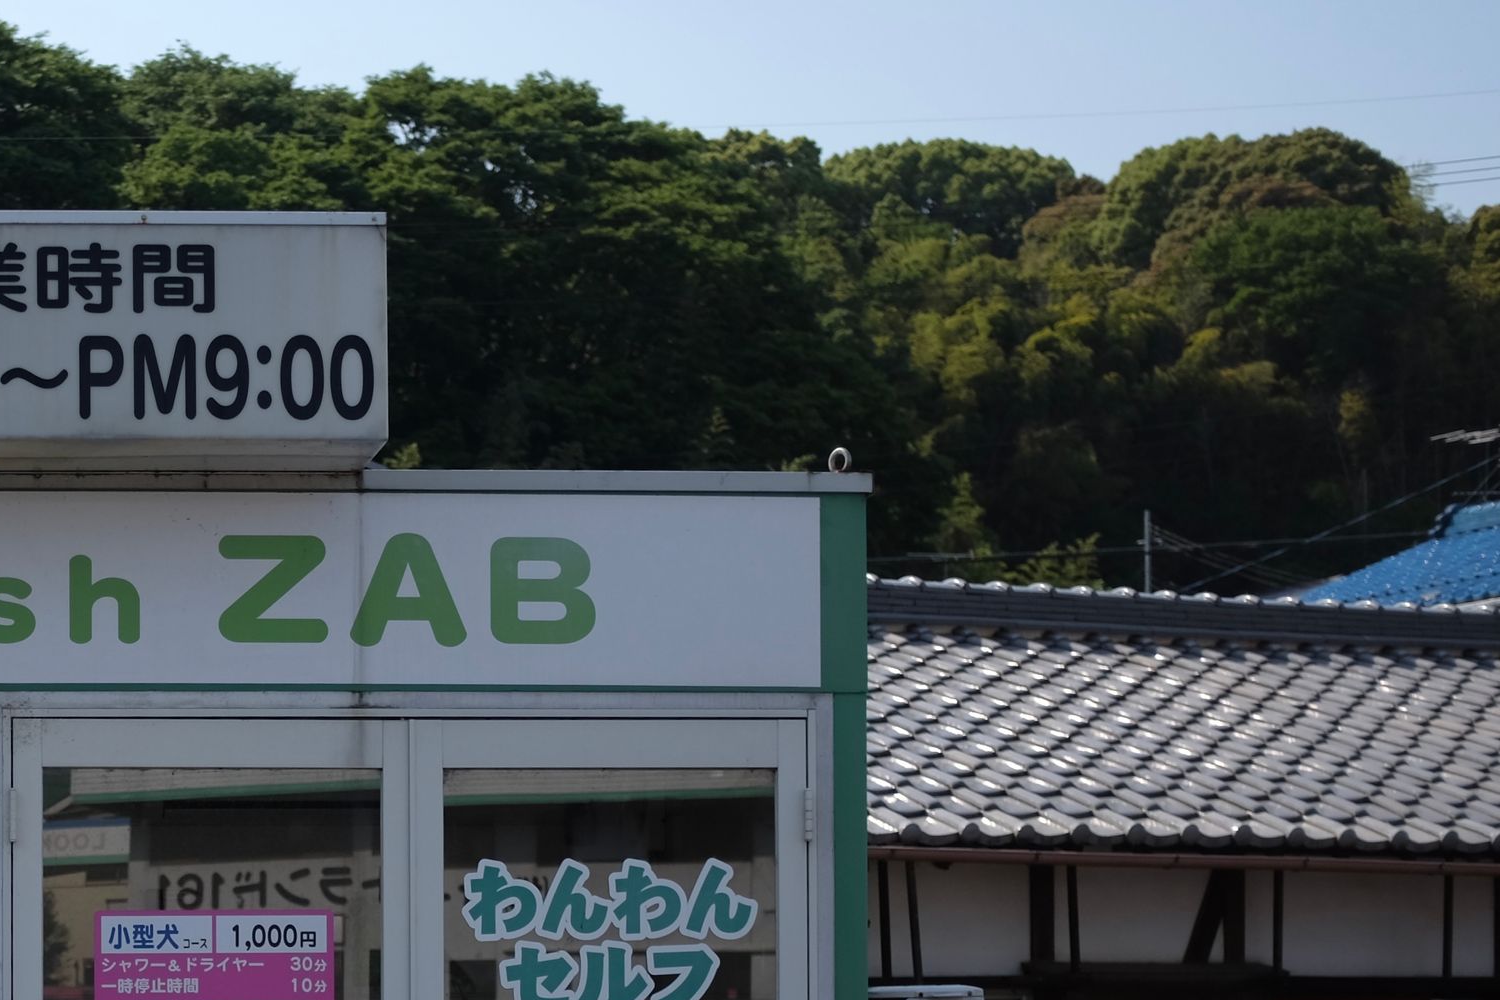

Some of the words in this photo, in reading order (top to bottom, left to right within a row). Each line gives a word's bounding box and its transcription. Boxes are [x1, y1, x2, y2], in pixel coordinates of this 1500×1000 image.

[217, 532, 597, 647] ZAB
[462, 858, 758, 941] わんわん
[232, 924, 317, 950] 1,000円
[101, 957, 264, 973] シャワー&ドライヤー
[290, 956, 327, 972] 30分
[101, 978, 199, 993] 一時停止時間
[291, 977, 327, 993] 10分
